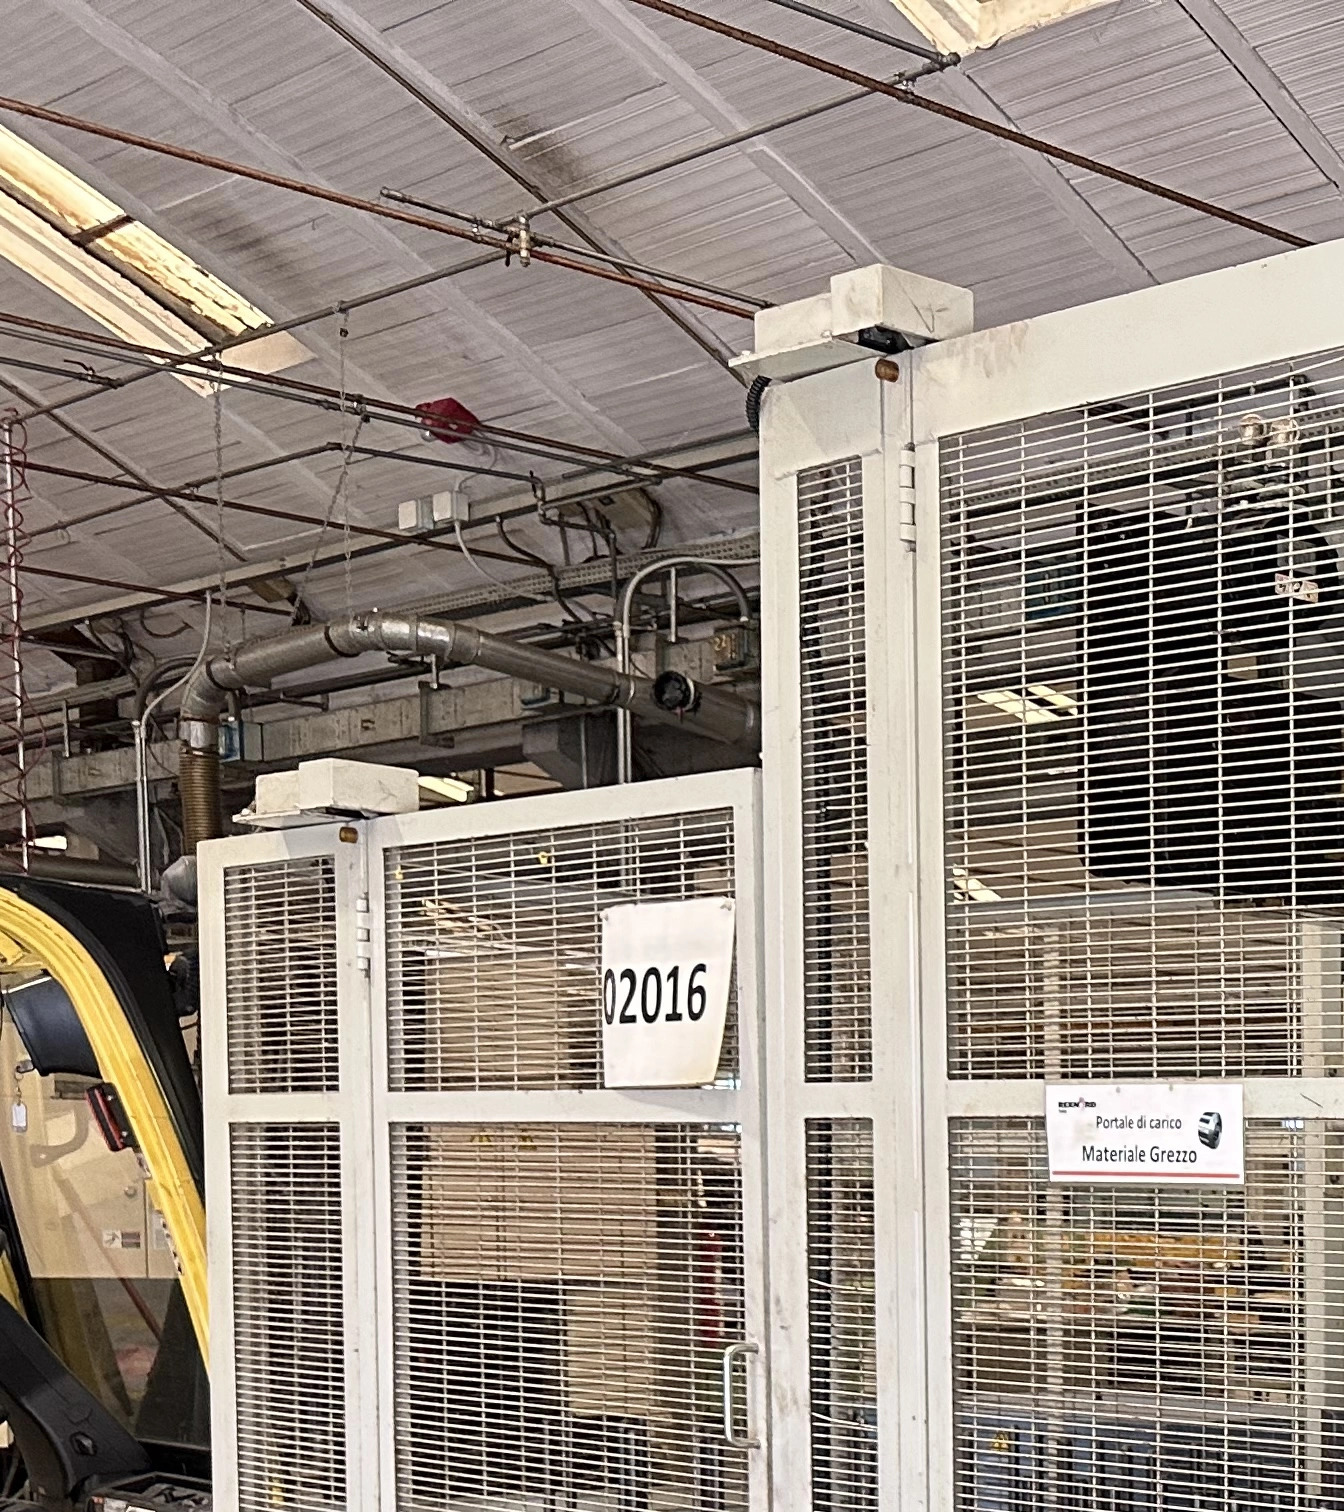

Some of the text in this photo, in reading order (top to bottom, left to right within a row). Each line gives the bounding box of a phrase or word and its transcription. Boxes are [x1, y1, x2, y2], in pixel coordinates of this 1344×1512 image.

[604, 963, 707, 1025] 02016
[1096, 1115, 1182, 1130] Portale di carico
[1082, 1144, 1197, 1163] Materiale Grezzo
